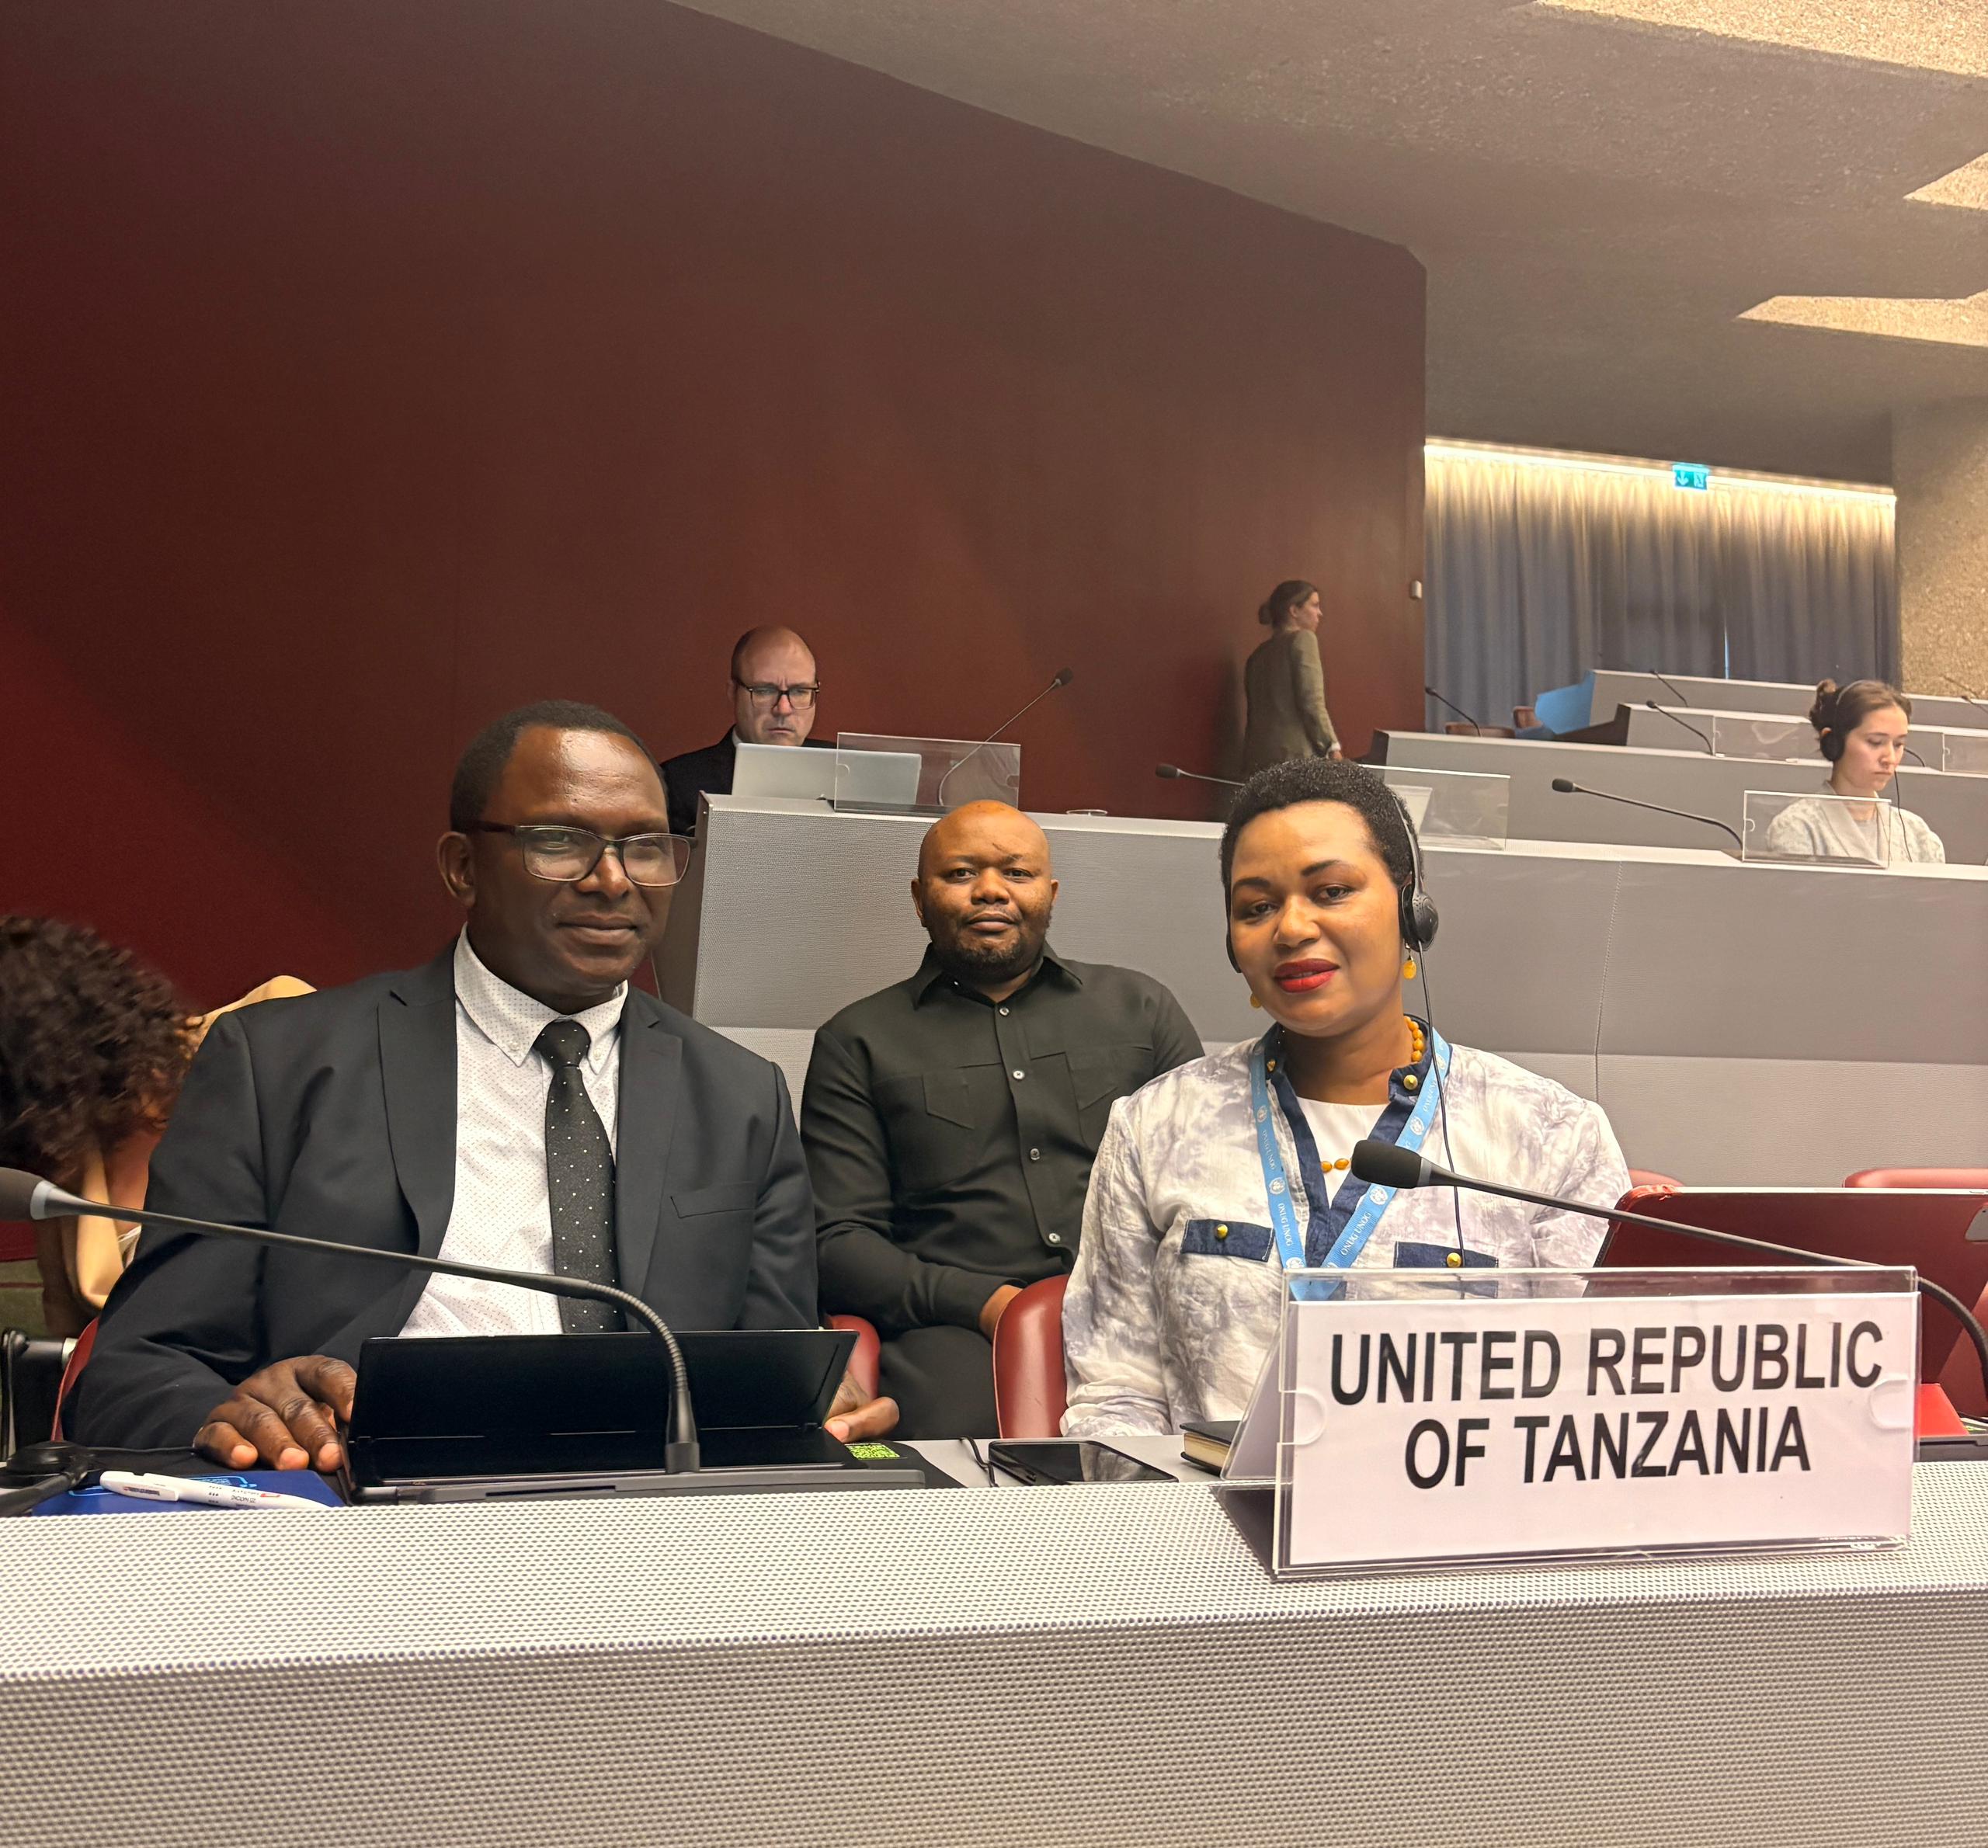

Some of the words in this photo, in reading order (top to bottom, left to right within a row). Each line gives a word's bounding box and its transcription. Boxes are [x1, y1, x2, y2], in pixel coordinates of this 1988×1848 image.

[1277, 1203, 1288, 1224] ONUG
[1282, 1224, 1293, 1246] UNOG
[1340, 1233, 1359, 1256] ONUG
[1354, 1212, 1371, 1234] UNOG
[1331, 1330, 1561, 1405] UNITED
[1587, 1321, 1883, 1397] REPUBLIC
[1405, 1418, 1490, 1489] OF
[1514, 1405, 1811, 1484] TANZANIA
